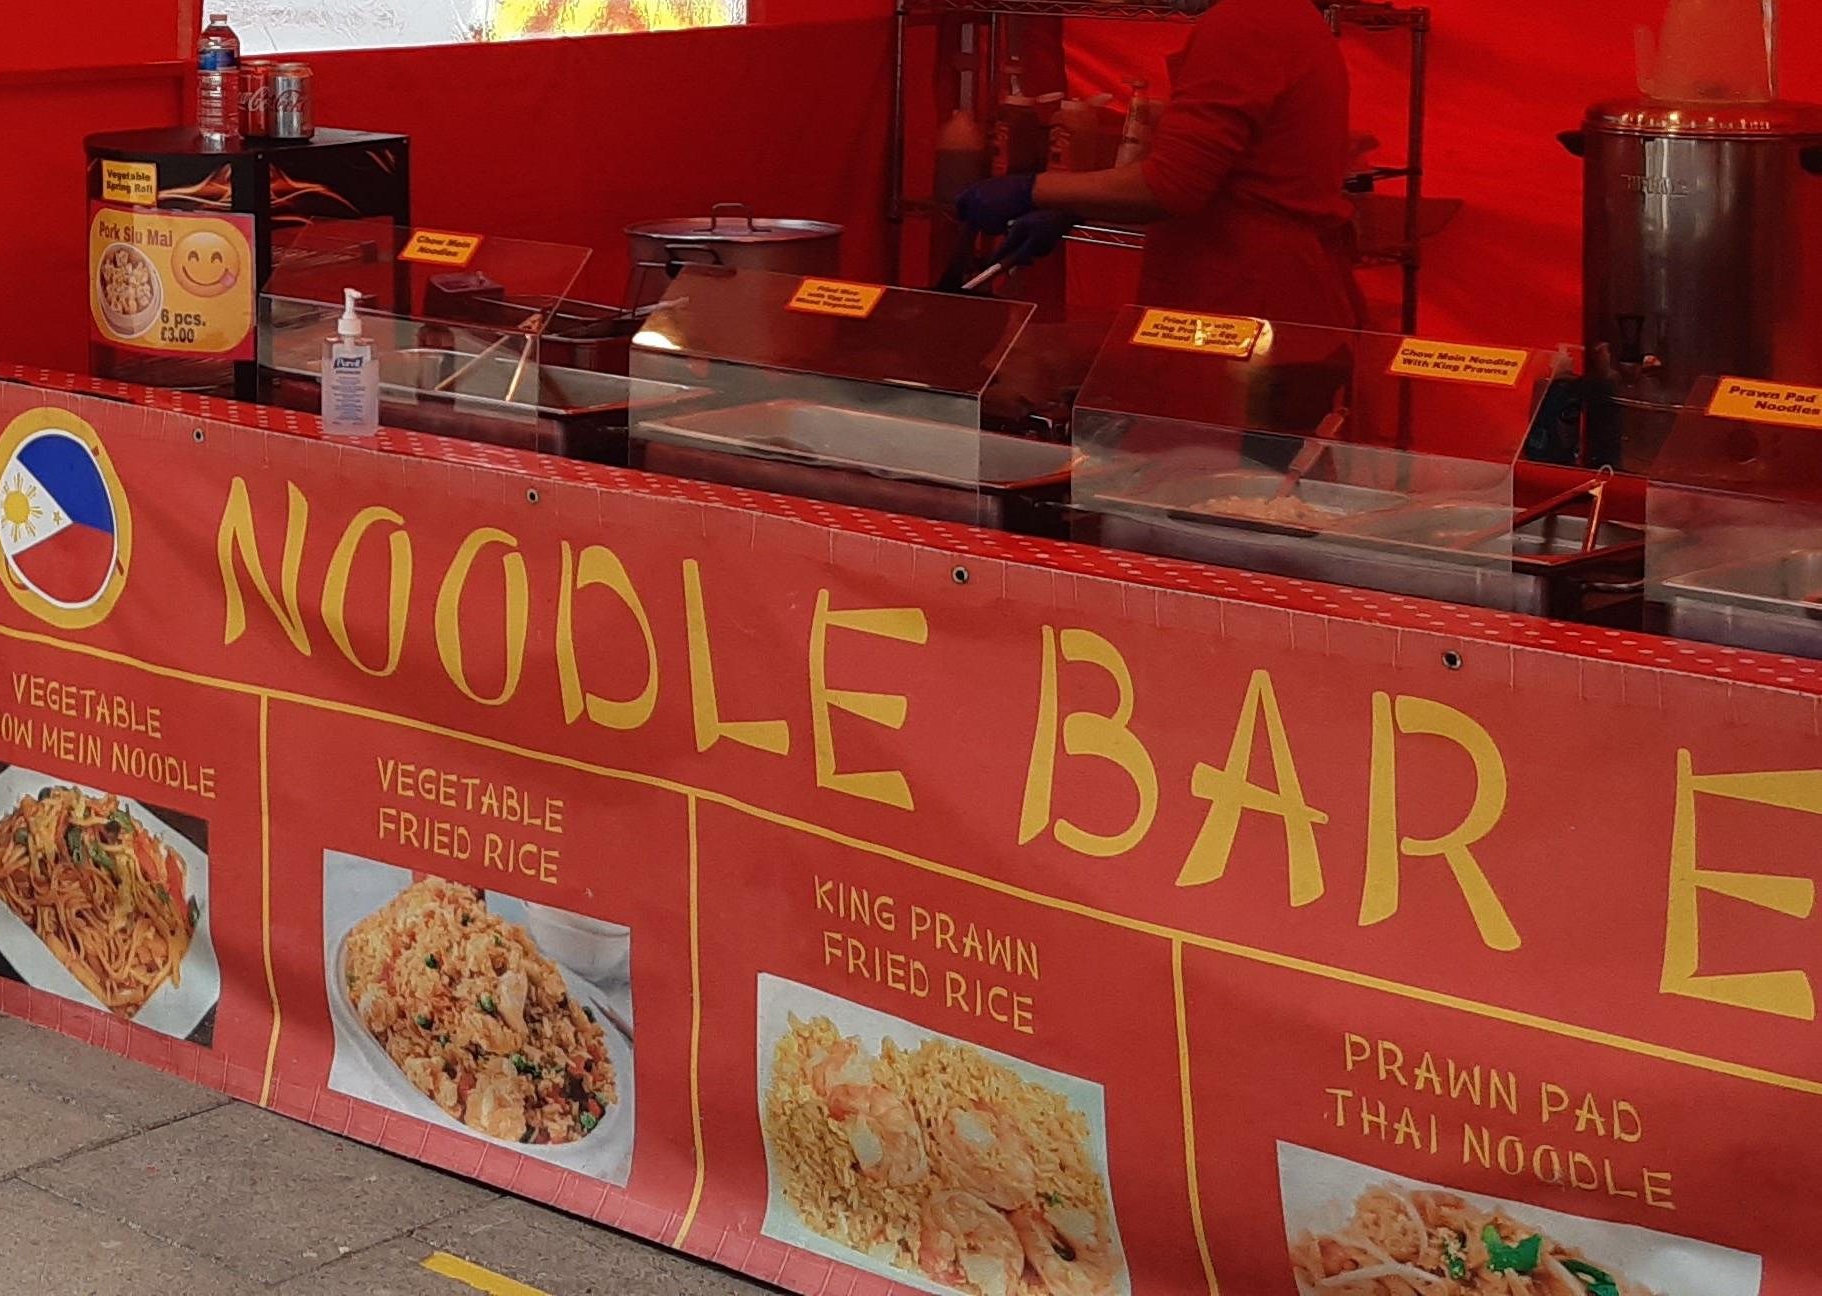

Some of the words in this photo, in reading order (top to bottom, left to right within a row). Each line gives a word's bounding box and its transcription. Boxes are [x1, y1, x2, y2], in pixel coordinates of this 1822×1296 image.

[106, 168, 151, 182] Vegetable
[106, 181, 131, 194] Spring
[98, 221, 120, 241] Pork
[160, 308, 169, 324] 6
[174, 311, 206, 328] pcs.
[160, 326, 195, 344] £3.00
[1729, 385, 1780, 399] Prawn
[1784, 392, 1817, 403] Pad
[1754, 400, 1821, 415] Noodles
[12, 671, 162, 740] VEGETABLE
[216, 476, 928, 812] NOODLE
[1018, 624, 1522, 953] BAR
[42, 722, 102, 768] MEIN
[111, 741, 216, 799] NOODLE
[377, 756, 564, 834] VEGETABLE
[378, 807, 472, 861] FRIED
[483, 833, 560, 885] RICE
[813, 874, 897, 934] KING
[909, 902, 1041, 983] PRAWN
[822, 931, 932, 1000] FRIED
[945, 970, 1035, 1036] RICE
[1344, 1032, 1518, 1116] PRAWN
[1538, 1079, 1645, 1144] PAD
[1325, 1088, 1439, 1156] THAI
[1463, 1115, 1676, 1211] NOODLE
